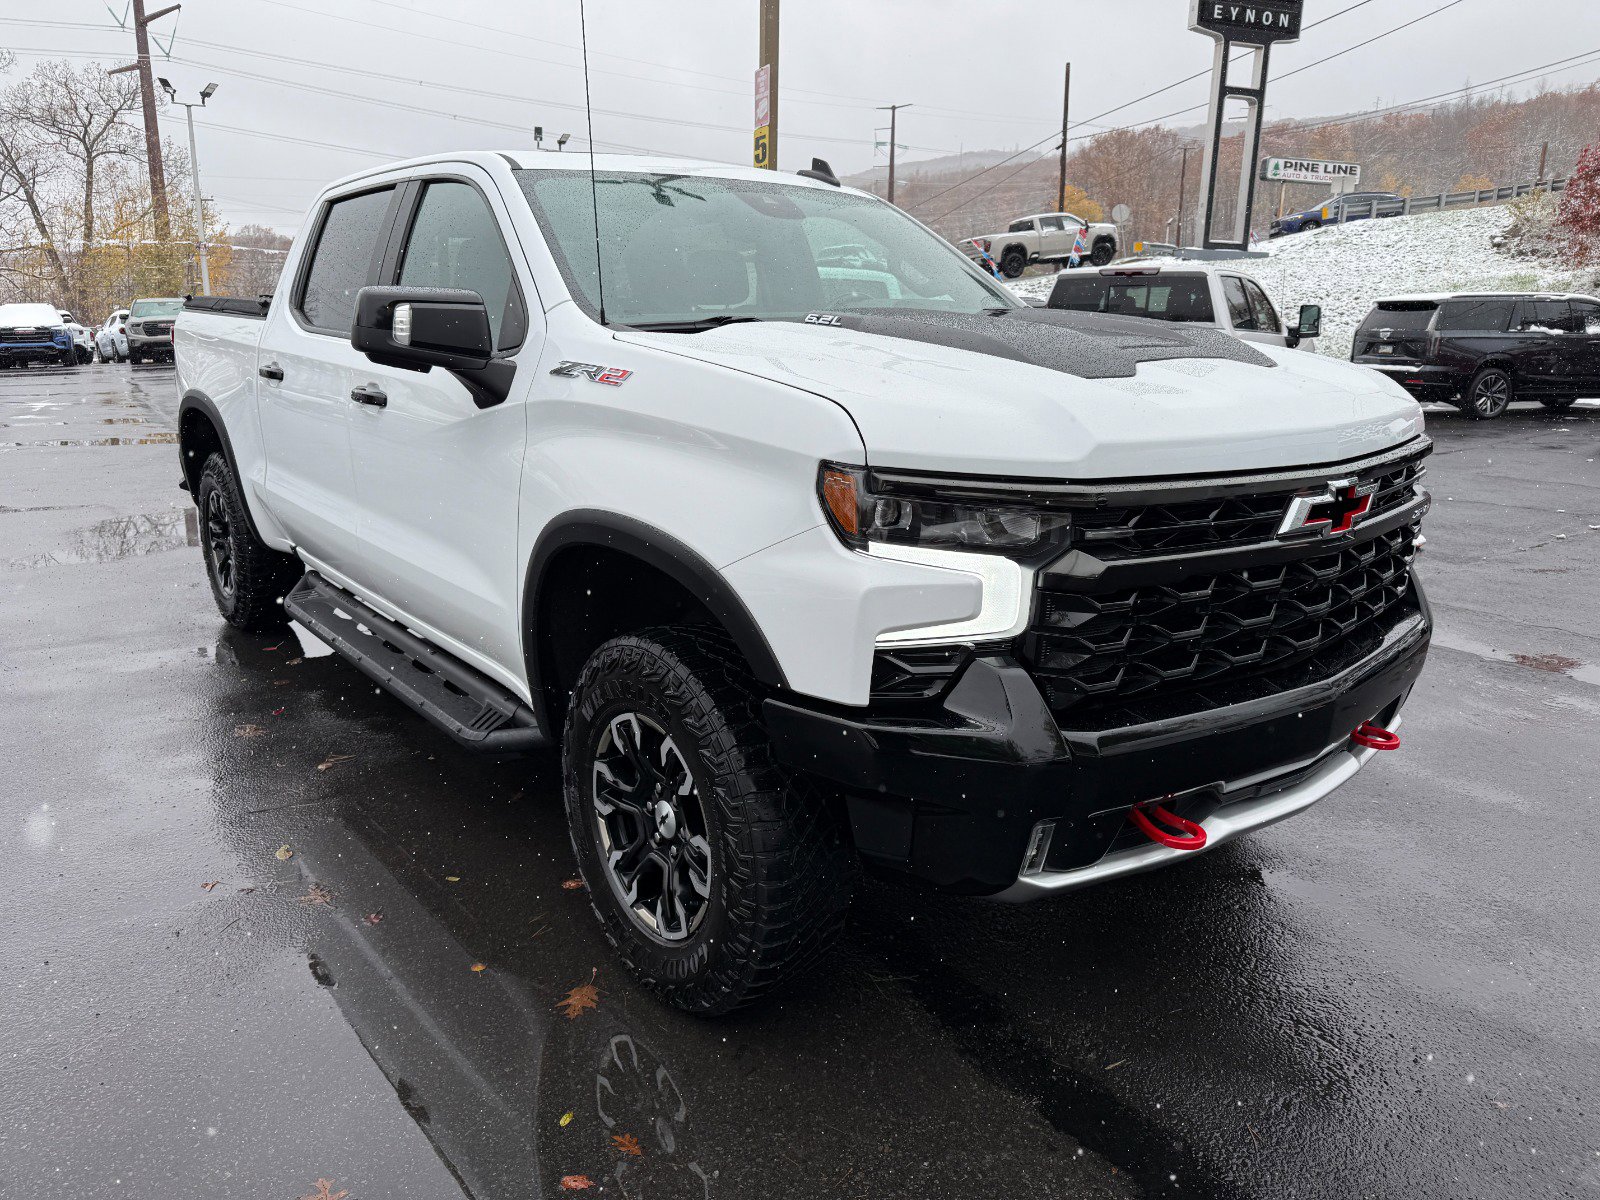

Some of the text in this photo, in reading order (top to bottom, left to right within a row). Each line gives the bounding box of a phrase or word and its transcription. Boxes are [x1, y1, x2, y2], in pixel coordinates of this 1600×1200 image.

[1213, 4, 1290, 28] EYNON
[754, 134, 767, 164] 5
[1283, 160, 1358, 176] PINE LINE
[804, 313, 842, 326] 6.2L
[549, 360, 634, 388] ZR2
